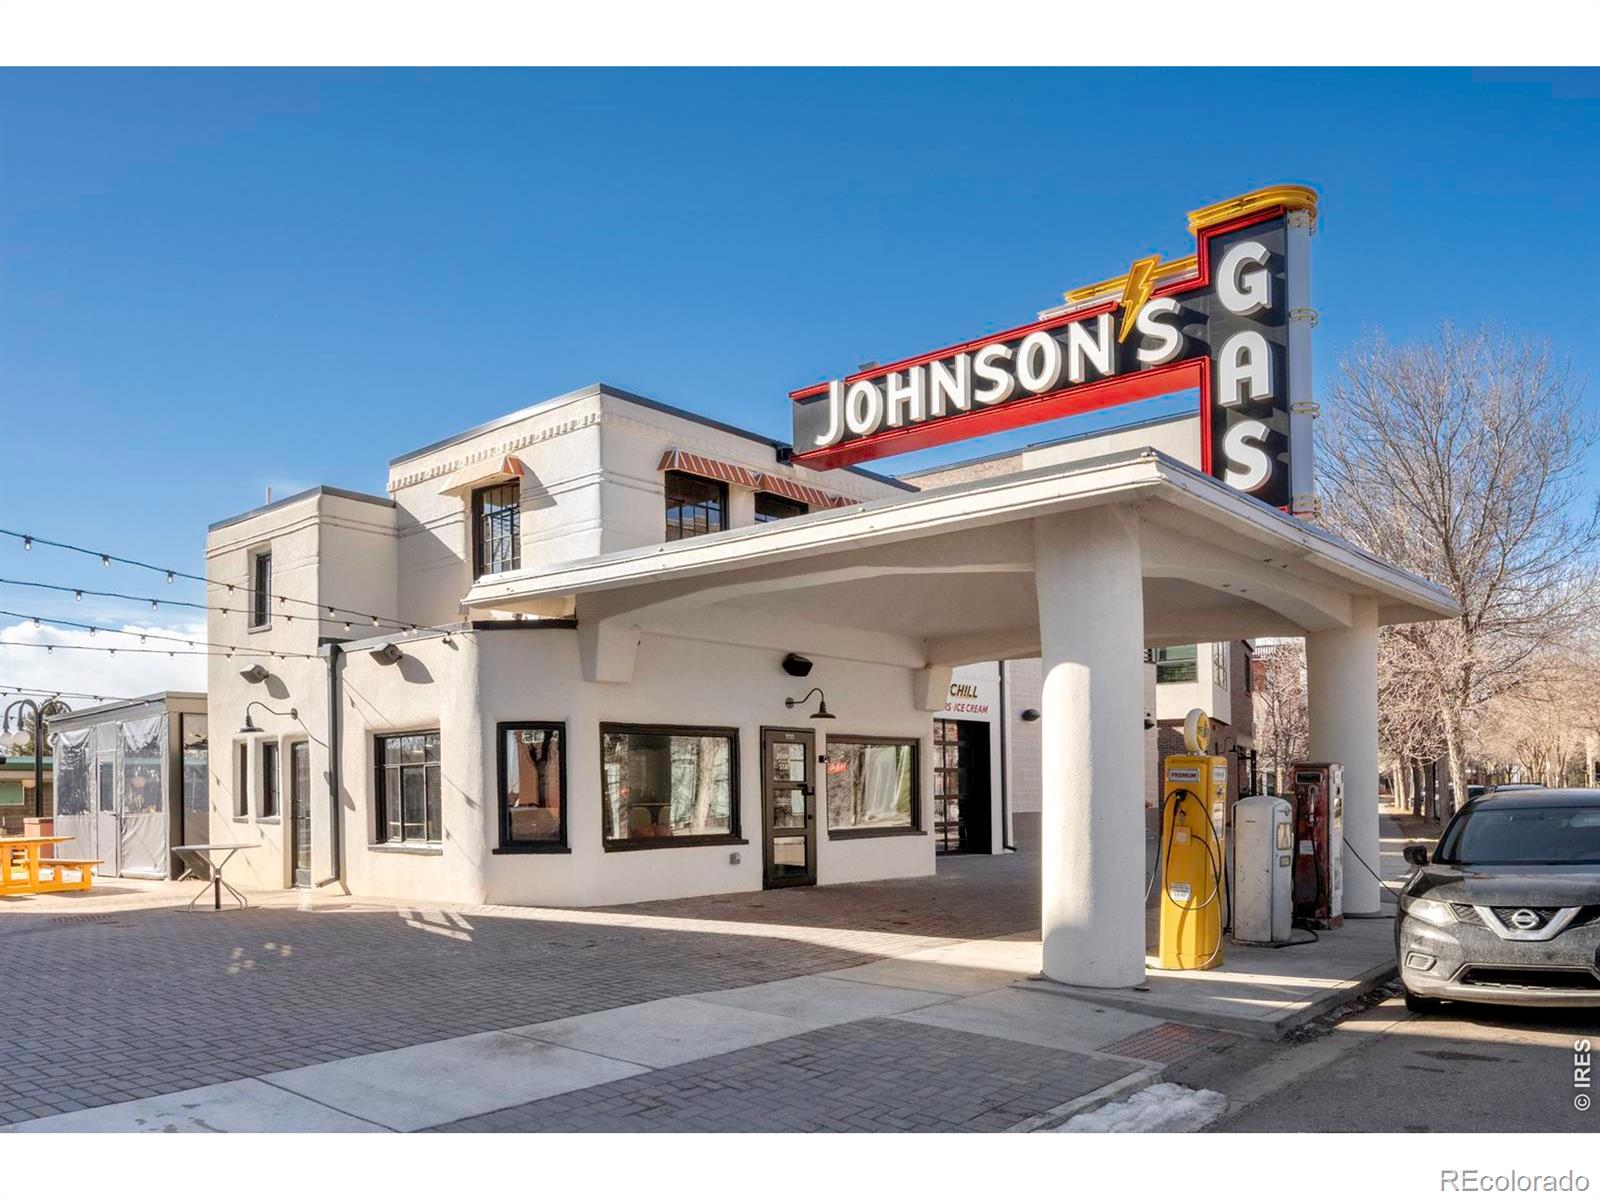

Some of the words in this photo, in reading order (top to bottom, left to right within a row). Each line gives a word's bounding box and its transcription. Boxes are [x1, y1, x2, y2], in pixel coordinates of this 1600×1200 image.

[1217, 241, 1272, 493] GAS
[950, 683, 978, 698] CHILL
[953, 703, 965, 712] ICE
[966, 703, 989, 713] CREAM
